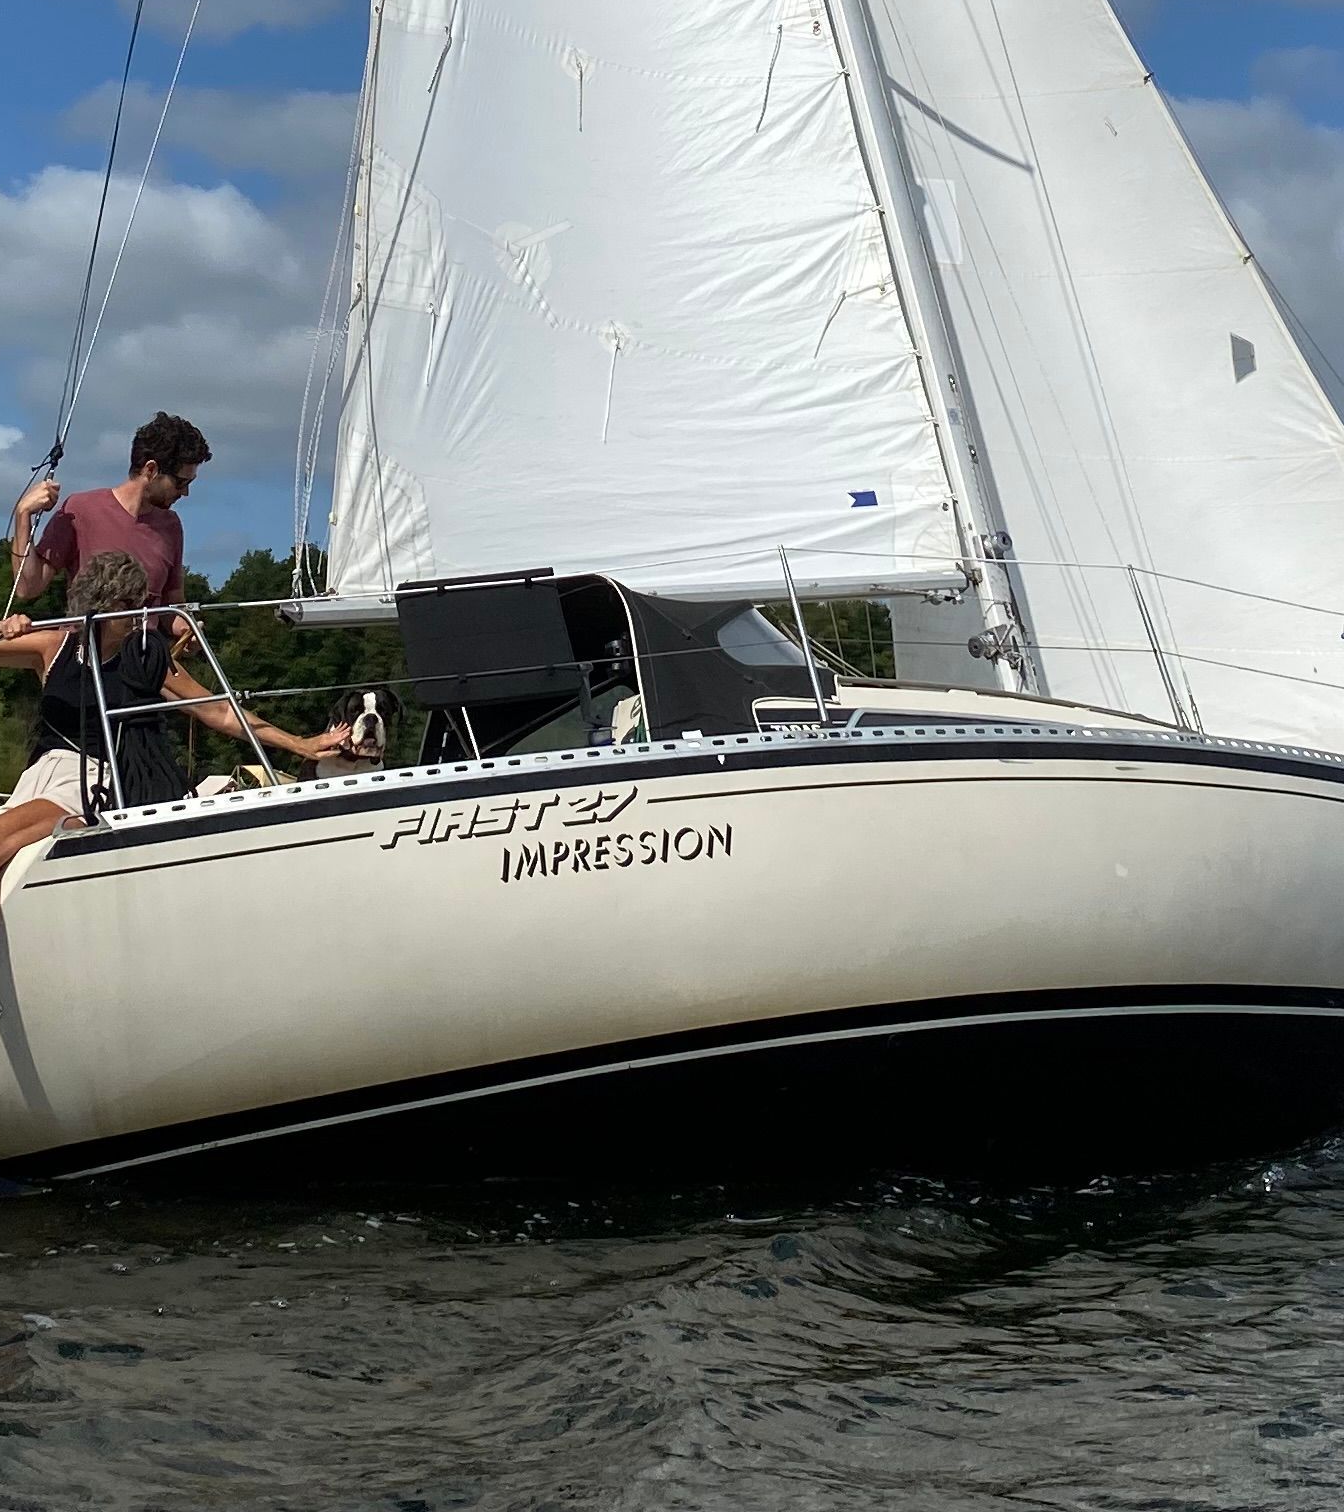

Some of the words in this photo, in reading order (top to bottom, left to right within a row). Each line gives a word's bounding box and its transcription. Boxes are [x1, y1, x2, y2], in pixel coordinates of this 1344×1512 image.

[379, 794, 560, 850] FIRST
[562, 786, 639, 827] 27
[500, 823, 732, 883] IMPRESSION
